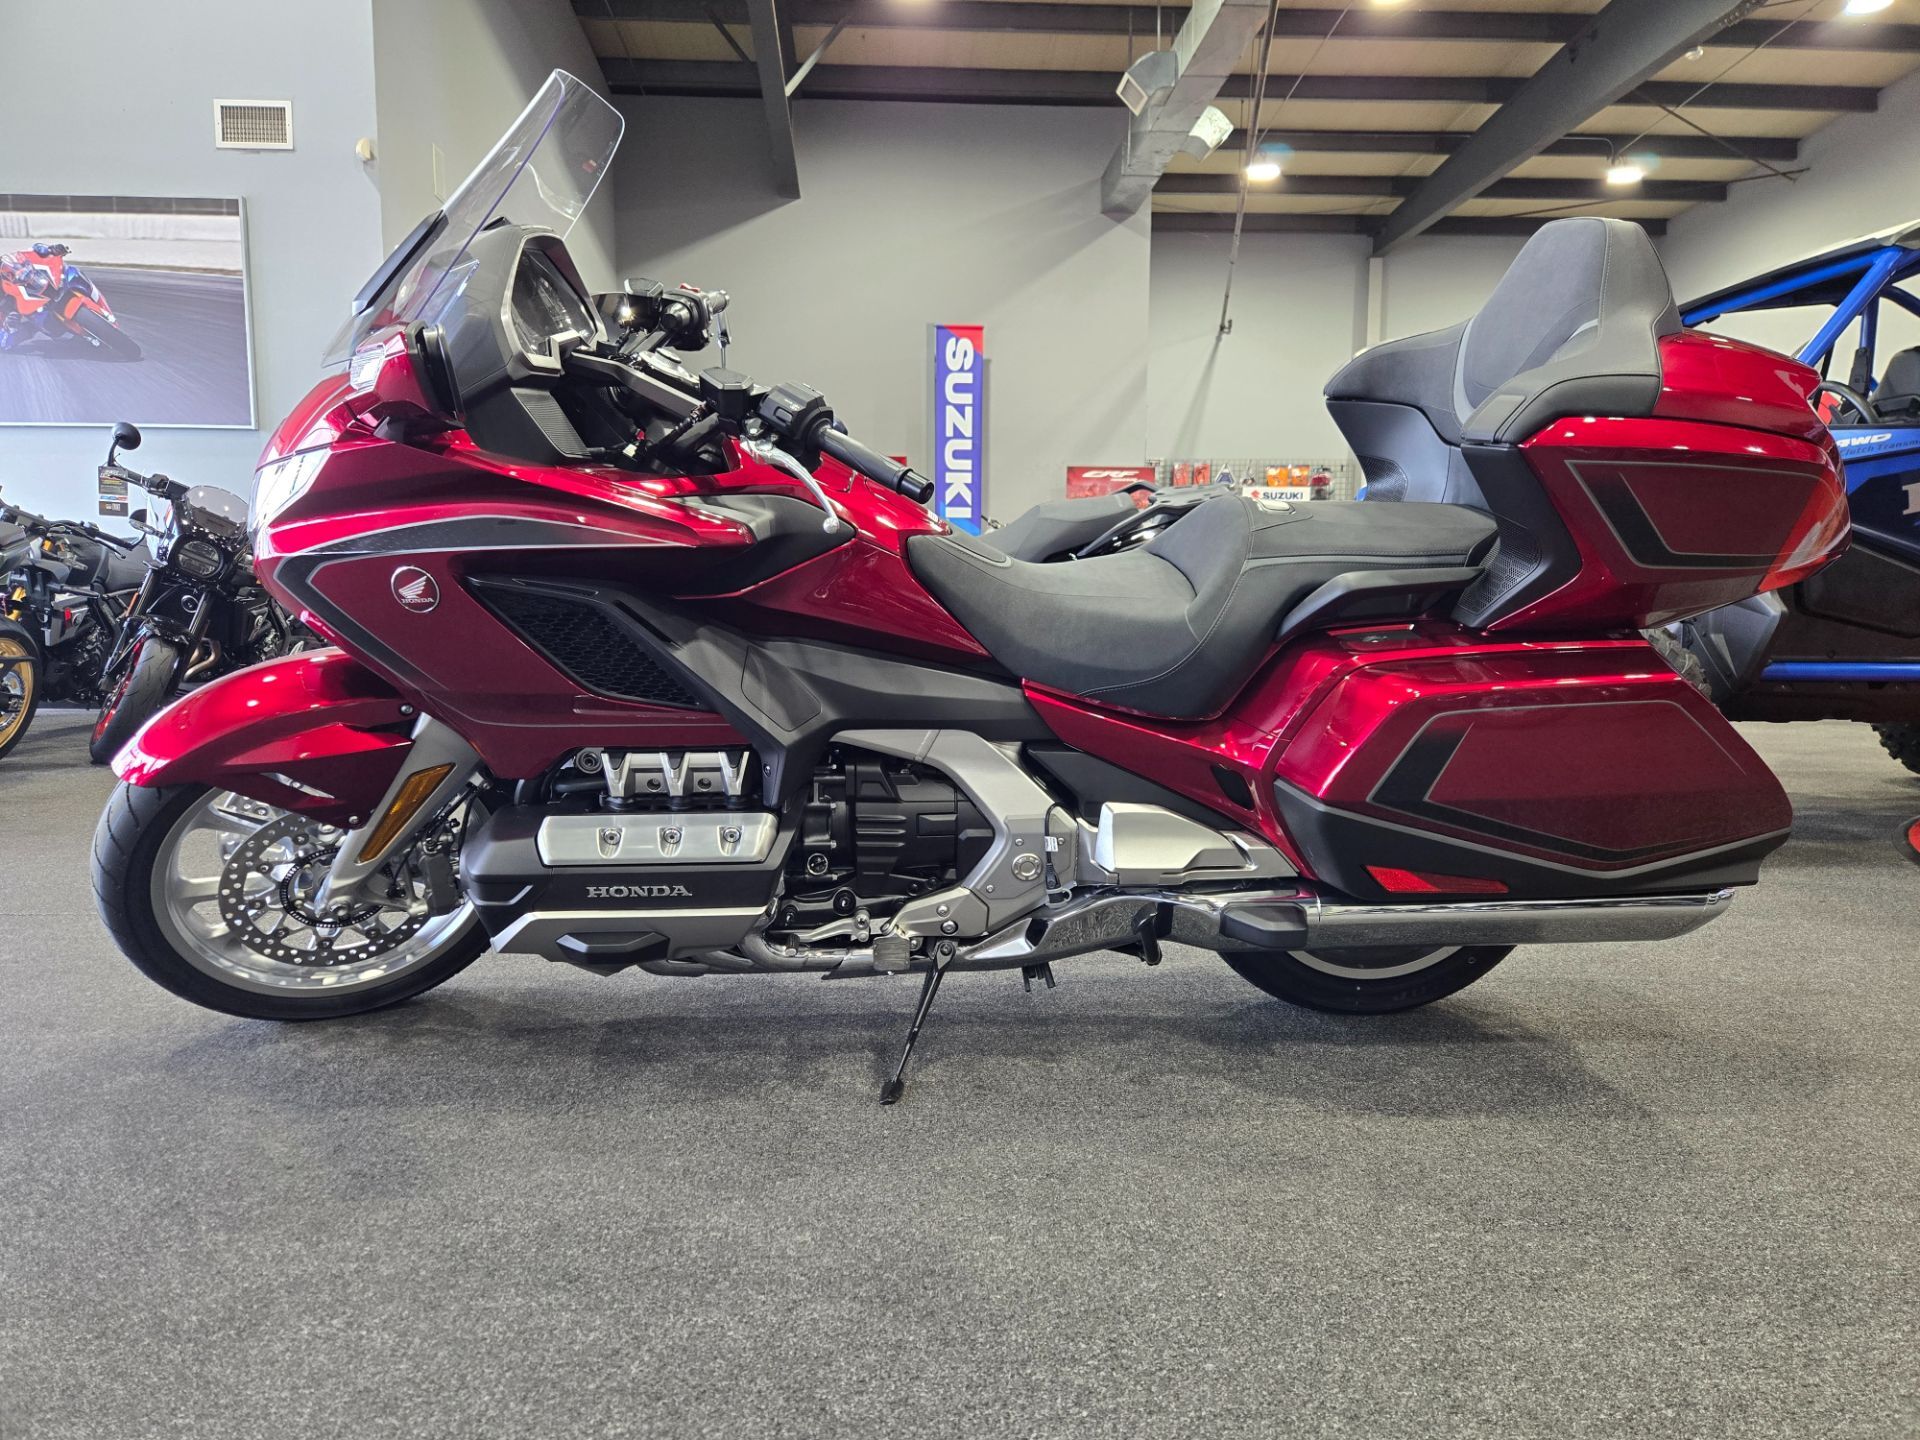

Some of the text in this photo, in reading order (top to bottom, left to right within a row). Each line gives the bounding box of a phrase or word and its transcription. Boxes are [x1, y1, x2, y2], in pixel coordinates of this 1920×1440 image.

[944, 337, 974, 519] SUZUKI
[1081, 470, 1140, 478] CRF
[1262, 491, 1304, 500] SUZUKI
[585, 885, 693, 898] HONDA
